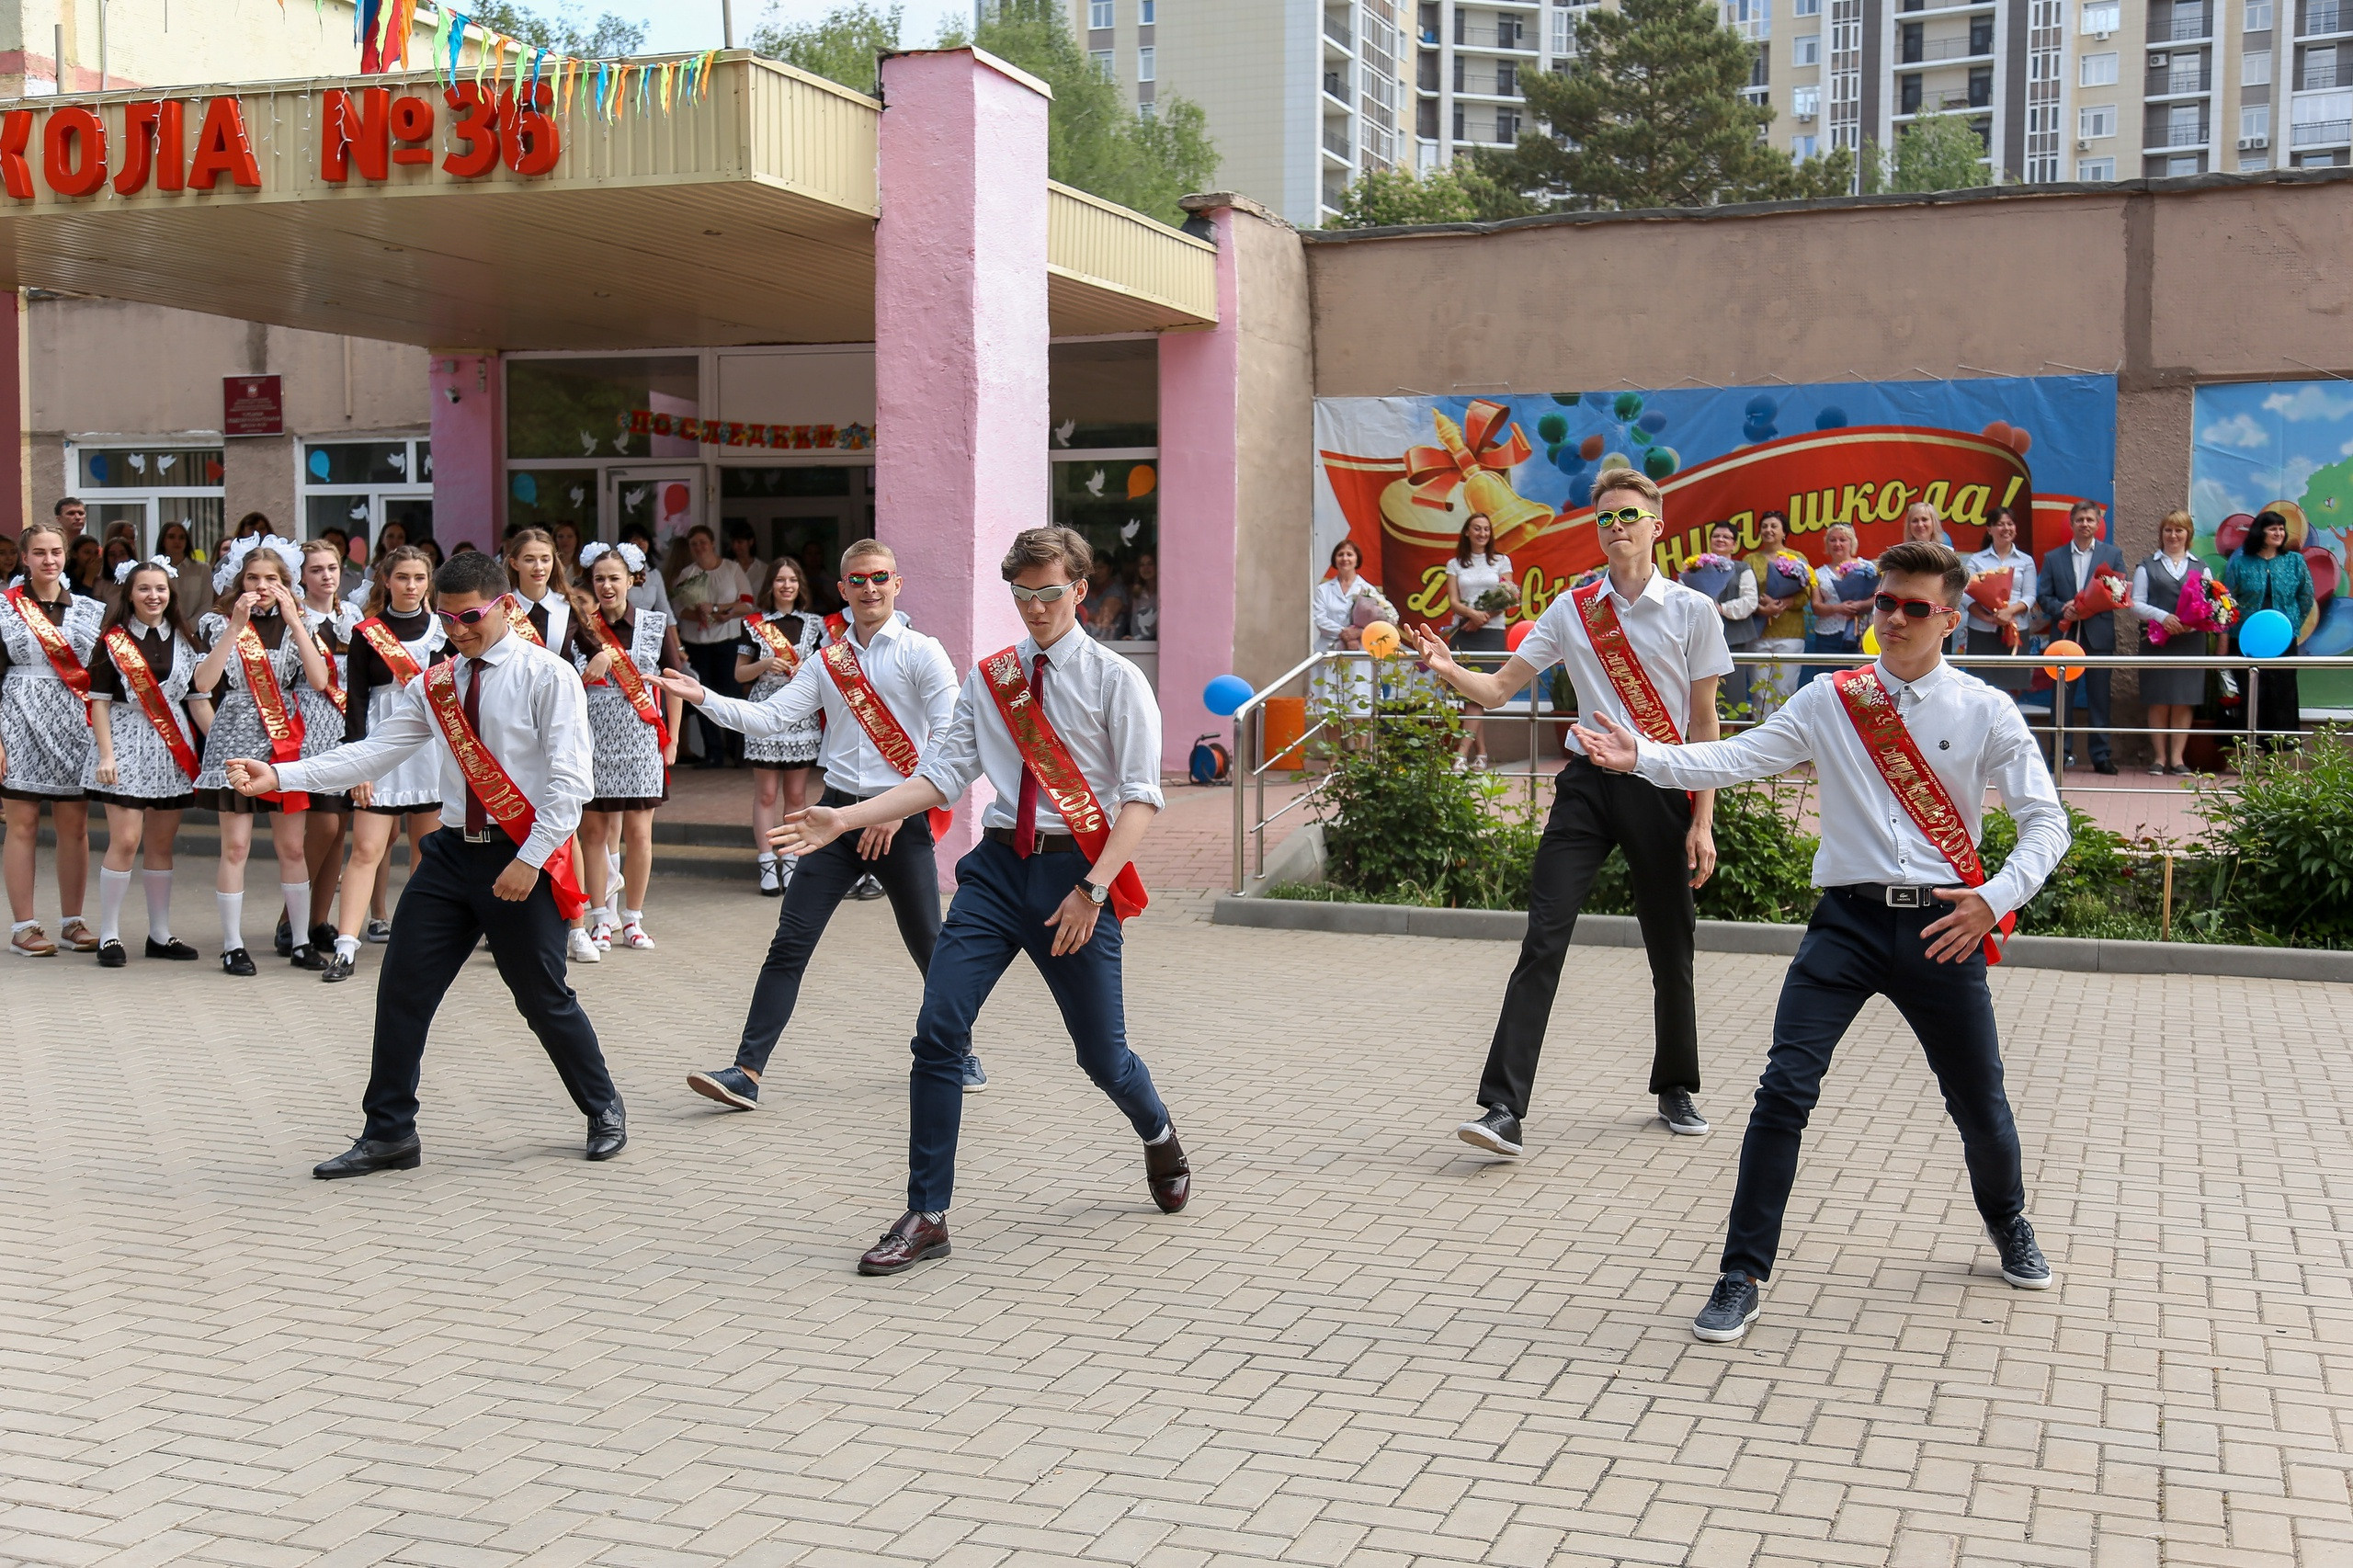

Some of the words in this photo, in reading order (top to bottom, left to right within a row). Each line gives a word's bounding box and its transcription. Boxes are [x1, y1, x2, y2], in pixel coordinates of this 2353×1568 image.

[628, 680, 652, 710] 2019
[261, 706, 290, 740] 2019
[876, 733, 919, 774] 2019
[473, 771, 526, 821] 2019
[1048, 778, 1101, 834] 2019
[1928, 814, 1976, 873] 2019
